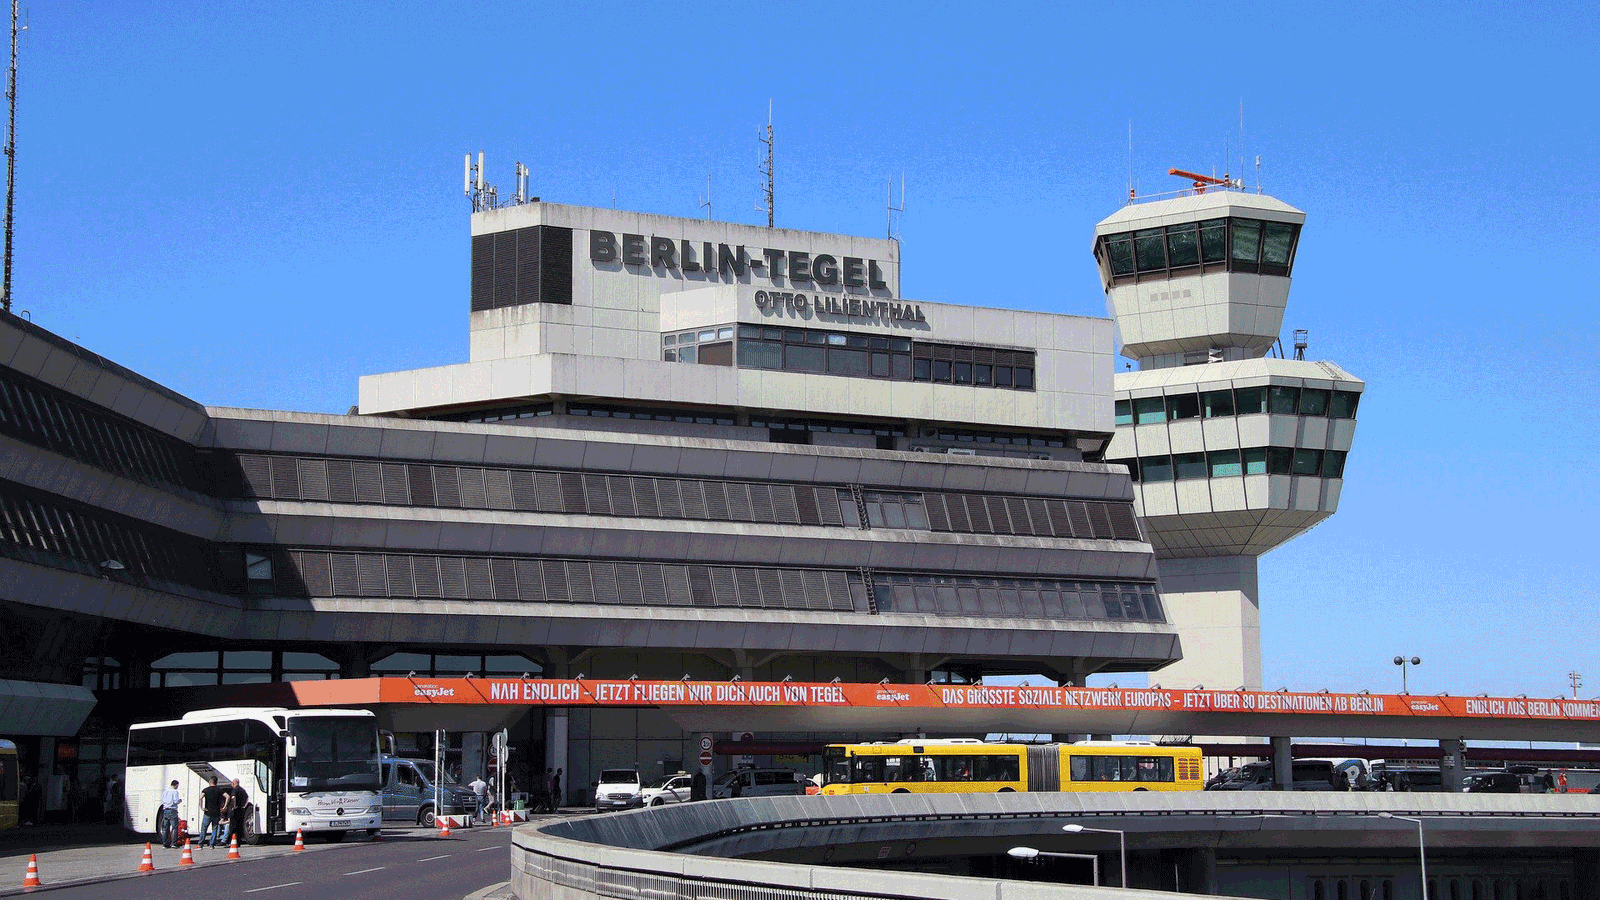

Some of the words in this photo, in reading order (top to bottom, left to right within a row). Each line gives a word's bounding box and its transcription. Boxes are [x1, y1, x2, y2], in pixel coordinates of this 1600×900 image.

[589, 228, 887, 290] BERLIN-TEGEL
[754, 289, 808, 309] OTTO
[813, 295, 926, 322] LILIENTHAL
[414, 687, 455, 698] easyJet
[490, 682, 519, 700] NAH
[523, 683, 579, 701] ENDLICH
[595, 684, 630, 701] JETZT
[634, 684, 685, 701] FLIEGEN
[688, 685, 713, 702] WIR
[716, 686, 745, 702] DICH
[749, 686, 780, 702] AUCH
[784, 686, 807, 703] VON
[810, 686, 846, 703] TEGEL
[876, 693, 910, 703] easyJet
[942, 688, 964, 705] DAS
[966, 687, 1015, 706] GRÖSSTE
[1018, 690, 1062, 706] SOZIALE
[1065, 691, 1122, 707] NETZWERK
[1124, 692, 1172, 708] EUROPAS
[1183, 693, 1211, 709] JETZT
[1214, 691, 1240, 709] ÜBER
[1242, 694, 1256, 710] 80
[1257, 694, 1332, 711] DESTINATIONEN
[1334, 697, 1348, 712] AB
[1350, 697, 1384, 712] BERLIN
[1410, 702, 1439, 712] easyJet
[1466, 700, 1505, 715] ENDLICH
[1507, 702, 1526, 716] AUS
[1528, 701, 1560, 717] BERLIN
